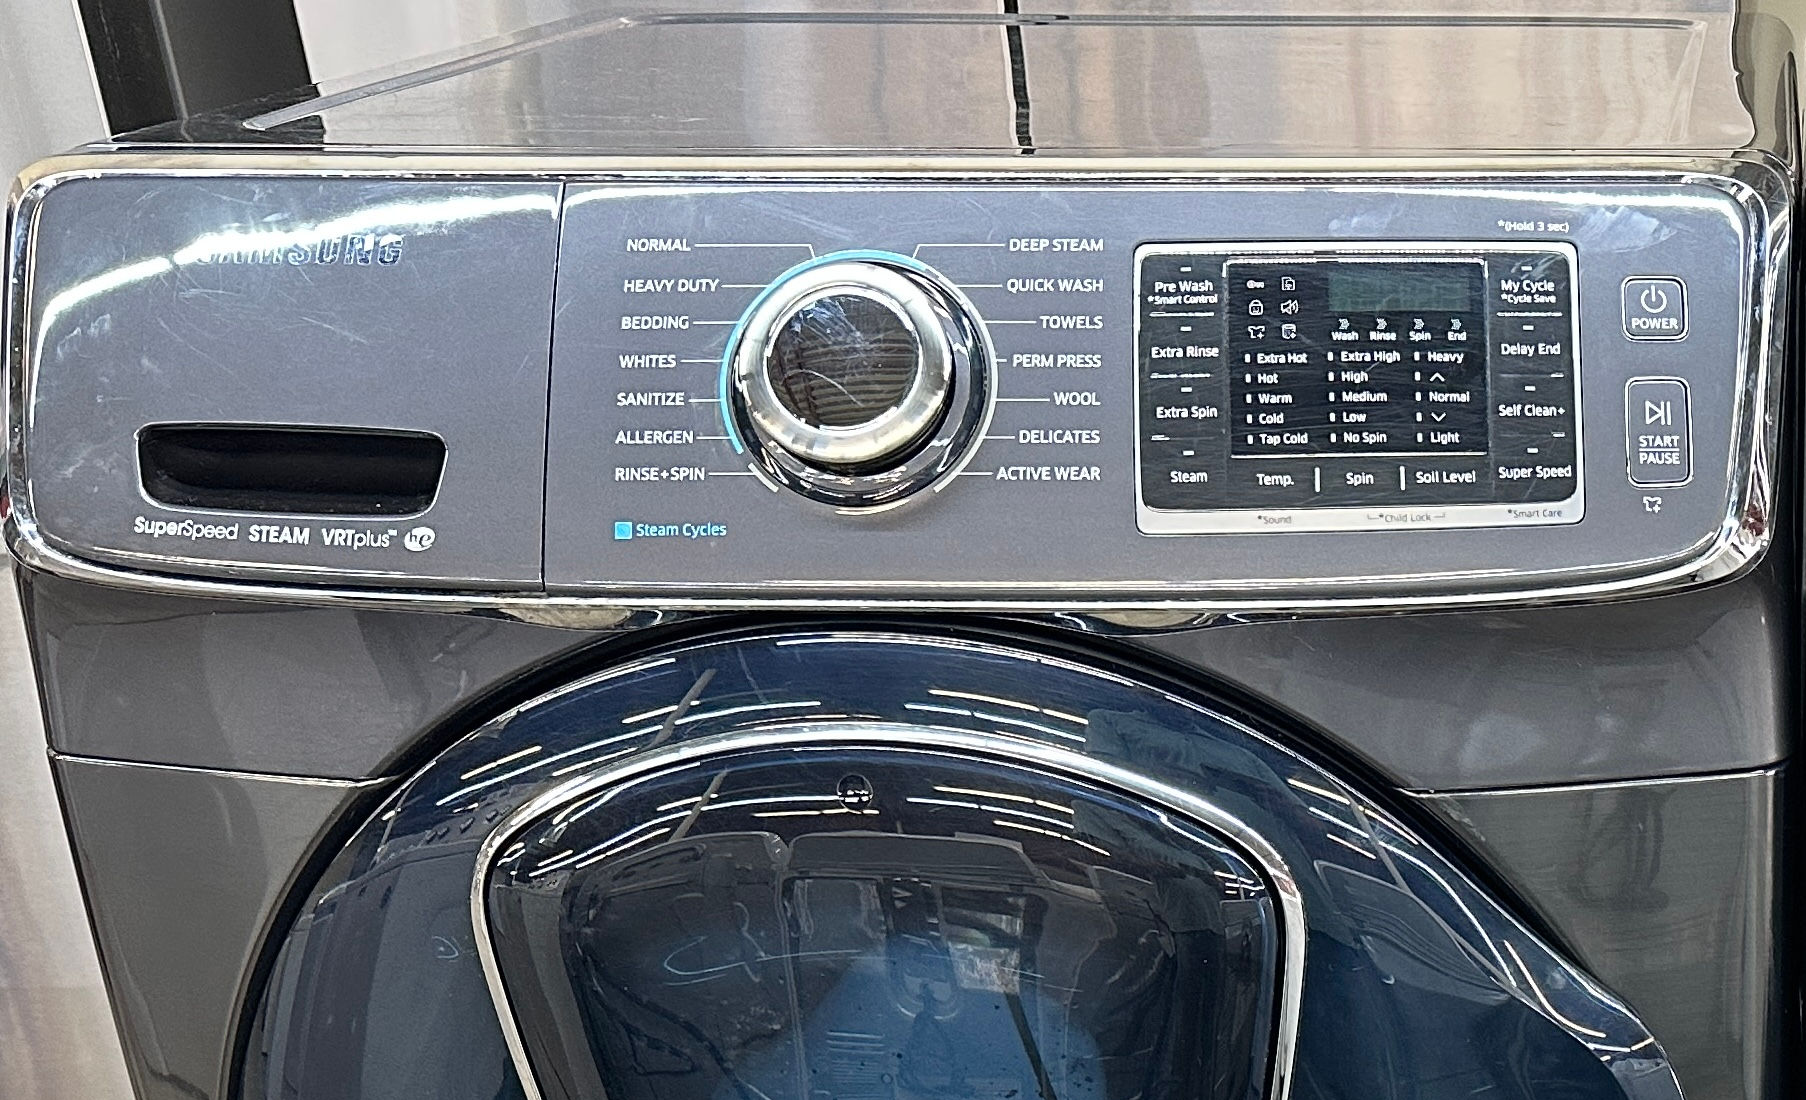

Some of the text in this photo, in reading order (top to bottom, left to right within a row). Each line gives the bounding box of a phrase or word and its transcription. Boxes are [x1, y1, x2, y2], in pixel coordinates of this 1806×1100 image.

[627, 239, 691, 251] NORMAL
[1010, 239, 1103, 251] DEEP STEAM
[624, 279, 719, 293] HEAVY DUTY
[1007, 279, 1103, 293] QUICK WASH
[1155, 280, 1213, 292] Pre Wash
[1501, 280, 1554, 293] My Cycle
[621, 316, 689, 329] BEDDING
[1040, 316, 1103, 329] TOWELS
[1632, 318, 1678, 329] POWER
[1332, 331, 1466, 341] Wash Spin End
[1152, 346, 1219, 358] Extra Rinse
[1501, 343, 1560, 356] Delay End
[619, 355, 676, 368] WHITES
[1013, 354, 1101, 367] PERM PRESS
[1258, 353, 1307, 363] Extra Hot
[1341, 351, 1400, 363] Extra High
[1428, 351, 1464, 363] Heavy
[1258, 374, 1278, 383] Hot
[1342, 371, 1368, 383] High
[617, 392, 684, 406] SANITIZE
[1054, 392, 1101, 405] WOOL
[1258, 394, 1292, 403] Warm
[1343, 391, 1387, 401] Medium
[1429, 391, 1469, 402] Normal
[1157, 406, 1217, 419] Extra Spin
[1499, 404, 1522, 416] Self
[1259, 413, 1284, 424] Cold
[1343, 412, 1366, 422] Low
[615, 430, 693, 444] ALLERGEN
[1019, 430, 1100, 443] DELICATES
[1259, 433, 1308, 446] Tap Cold
[1344, 432, 1387, 444] No Spin
[1431, 432, 1459, 444] Light
[1639, 435, 1679, 447] START
[1640, 453, 1680, 464] PAUSE
[615, 467, 704, 481] RINSE+SPIN
[996, 466, 1100, 480] ACTIVE WEAR
[1171, 471, 1207, 482] Steam
[1416, 470, 1476, 483] Soil Level
[1499, 465, 1571, 480] Super Speed
[1256, 474, 1294, 487] Temp.
[1346, 472, 1374, 486] Spin
[134, 516, 238, 540] SuperSpeed
[249, 525, 310, 545] STEAM
[637, 522, 726, 539] Steam Cycles
